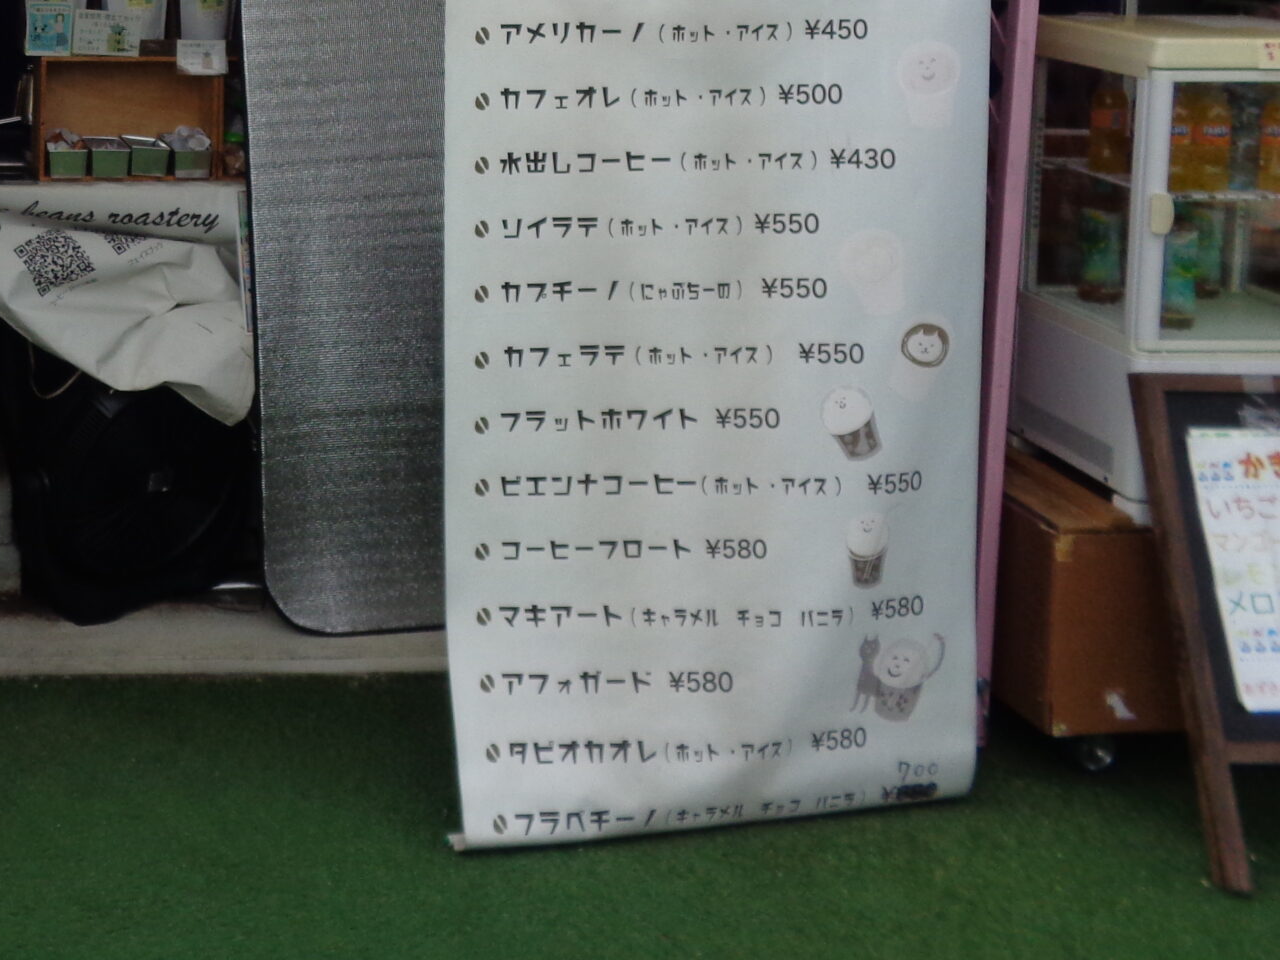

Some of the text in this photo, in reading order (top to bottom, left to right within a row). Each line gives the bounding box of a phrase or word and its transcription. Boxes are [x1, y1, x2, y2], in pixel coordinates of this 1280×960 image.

[805, 19, 868, 40] ¥450
[778, 83, 843, 105] ¥500
[830, 148, 896, 169] ¥430
[20, 200, 96, 223] beans
[108, 207, 220, 234] roastery
[754, 213, 819, 234] ¥550
[761, 277, 827, 299] ¥550
[798, 342, 864, 364] ¥550
[500, 407, 780, 432] フラットホワイト ¥550
[867, 470, 922, 495] ¥550
[501, 538, 767, 560] コーヒーフロート ¥580
[872, 594, 924, 620] ¥580
[501, 670, 733, 695] アフォガード ¥580
[810, 726, 866, 751] ¥580
